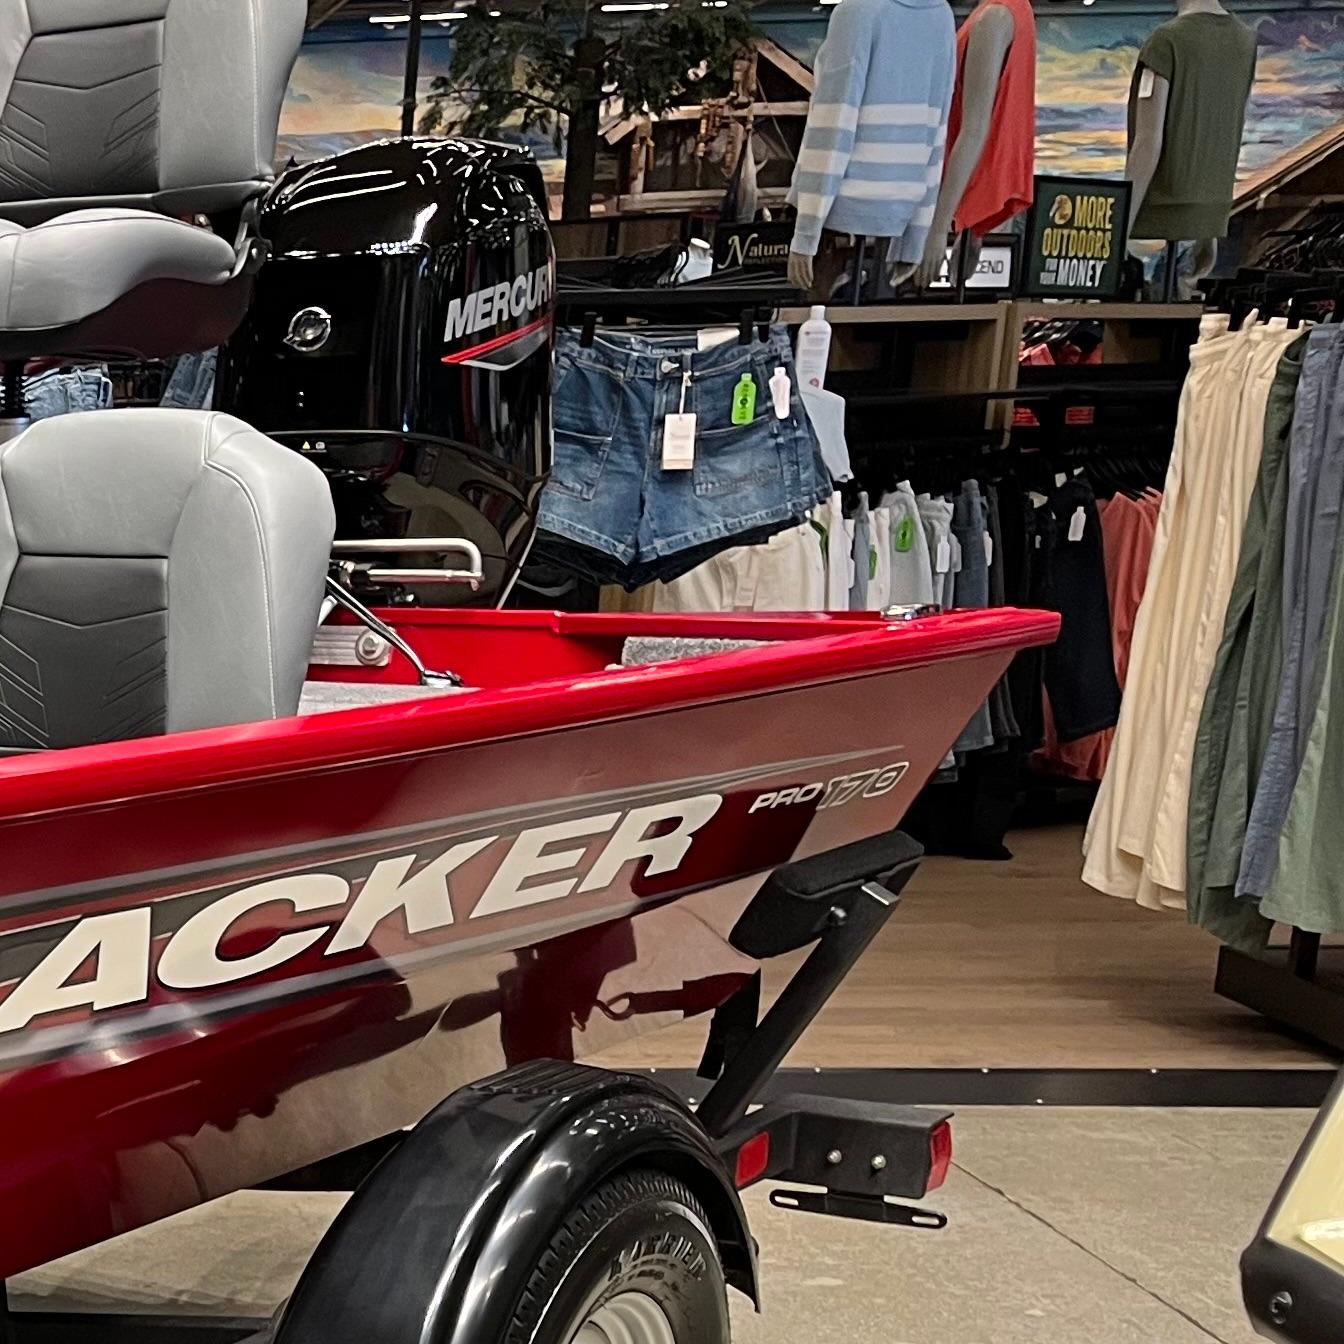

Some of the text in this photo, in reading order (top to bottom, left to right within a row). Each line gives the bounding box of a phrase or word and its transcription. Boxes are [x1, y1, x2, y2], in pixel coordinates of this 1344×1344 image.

[1074, 195, 1115, 229] MORE
[717, 233, 788, 269] Natura
[1042, 228, 1112, 259] OUTDOORS
[1057, 259, 1105, 287] MONEY
[443, 264, 550, 343] MERCUR
[748, 761, 910, 814] PRO 170
